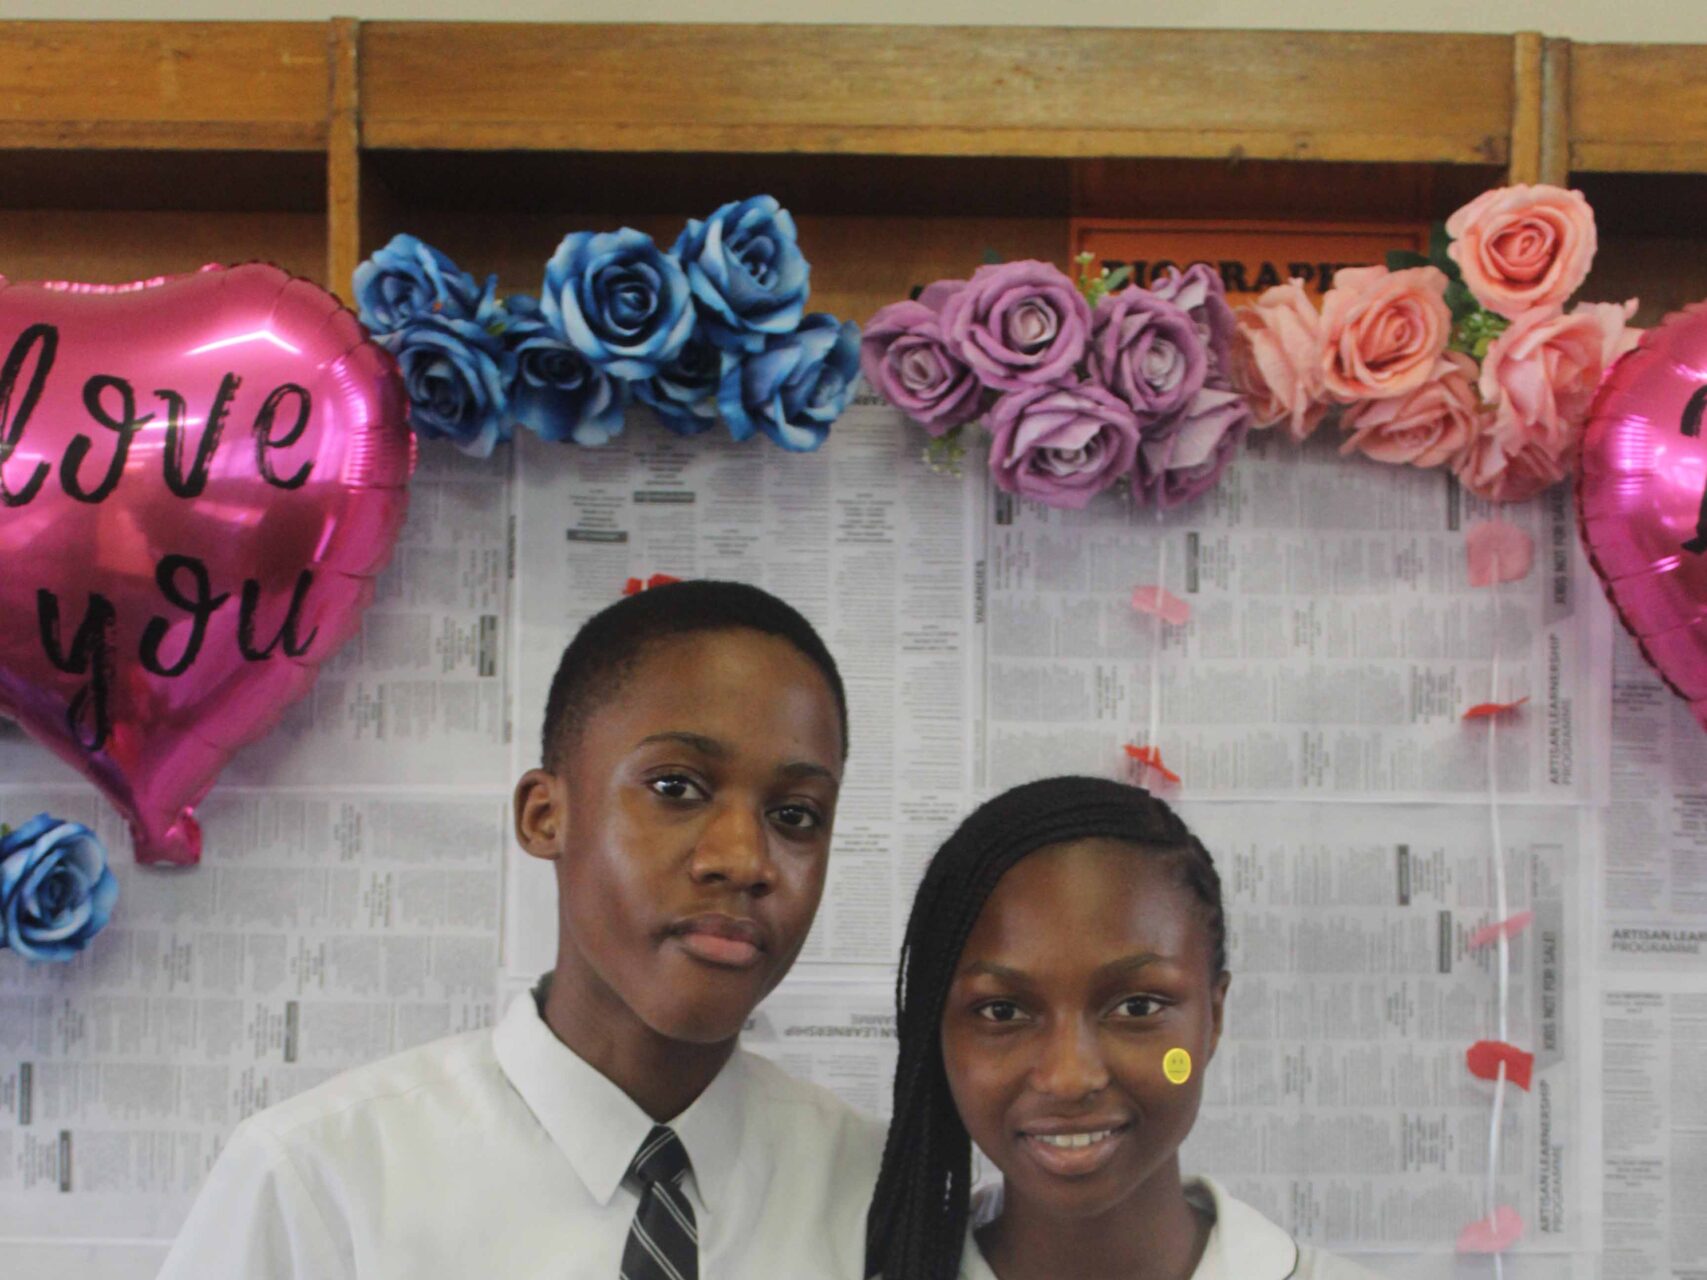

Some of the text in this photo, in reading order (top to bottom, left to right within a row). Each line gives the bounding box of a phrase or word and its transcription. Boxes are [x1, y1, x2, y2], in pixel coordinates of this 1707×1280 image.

[0, 323, 315, 508] love
[37, 553, 319, 751] you
[1612, 928, 1670, 941] ARTISAN
